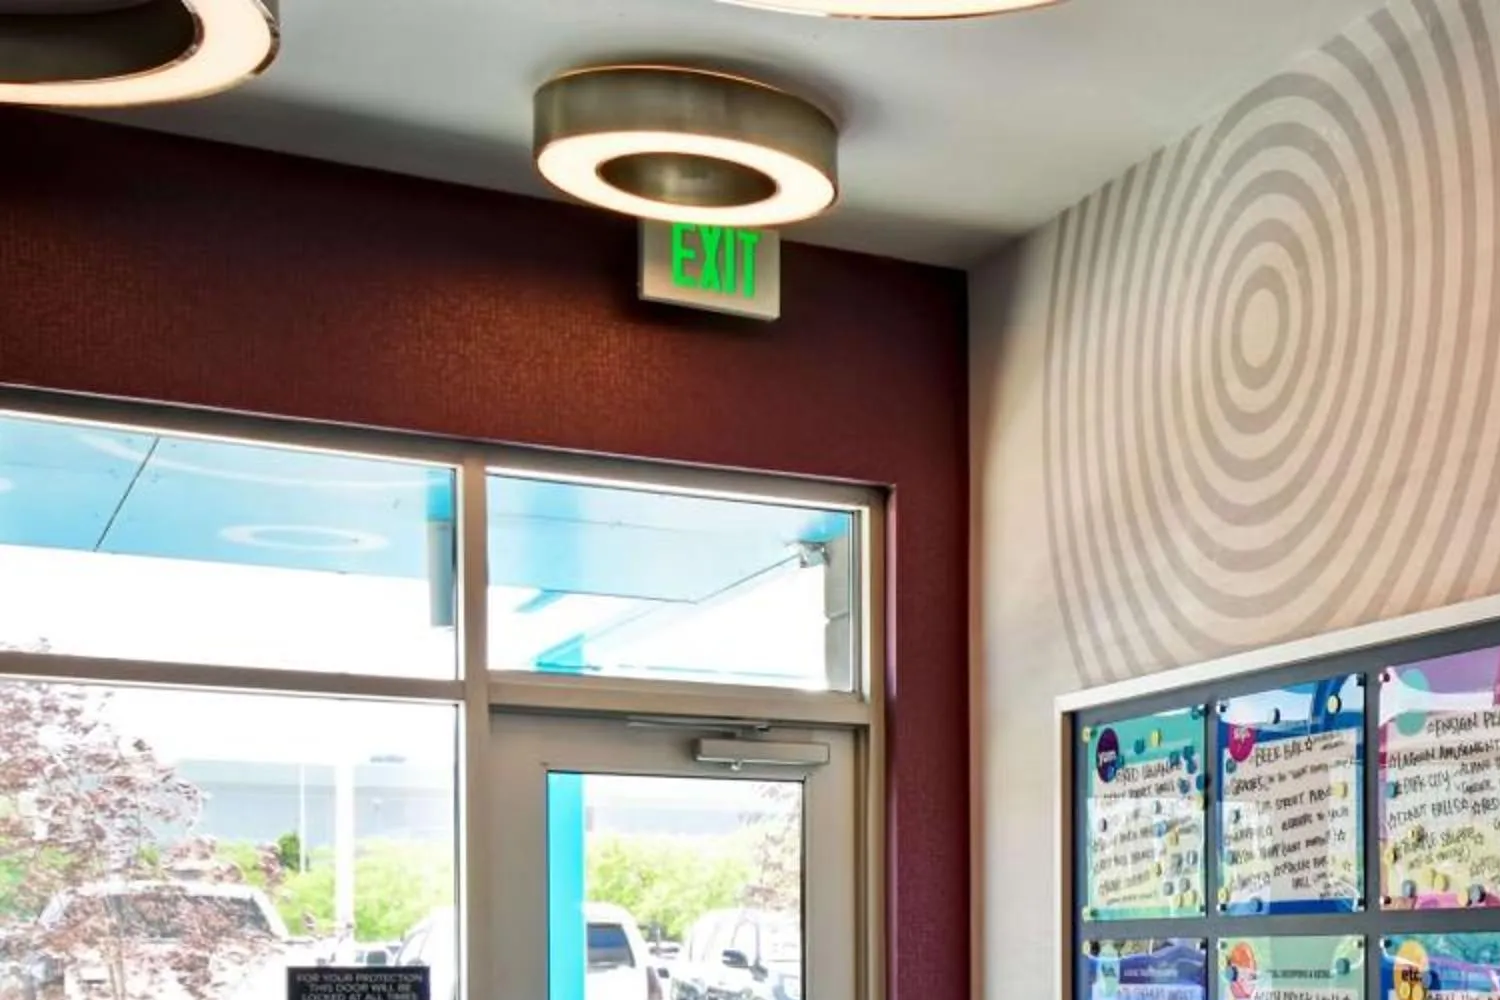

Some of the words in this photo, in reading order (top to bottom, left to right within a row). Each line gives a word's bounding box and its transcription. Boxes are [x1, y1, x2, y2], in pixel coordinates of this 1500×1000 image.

[672, 222, 761, 298] EXIT
[297, 973, 320, 982] FOR
[322, 973, 353, 982] YOUR
[356, 972, 423, 982] PROTECTION
[1401, 967, 1423, 982] etc.
[309, 984, 334, 993] THIS
[336, 983, 369, 993] DOOR
[371, 983, 394, 993] WILL
[397, 983, 412, 993] BE
